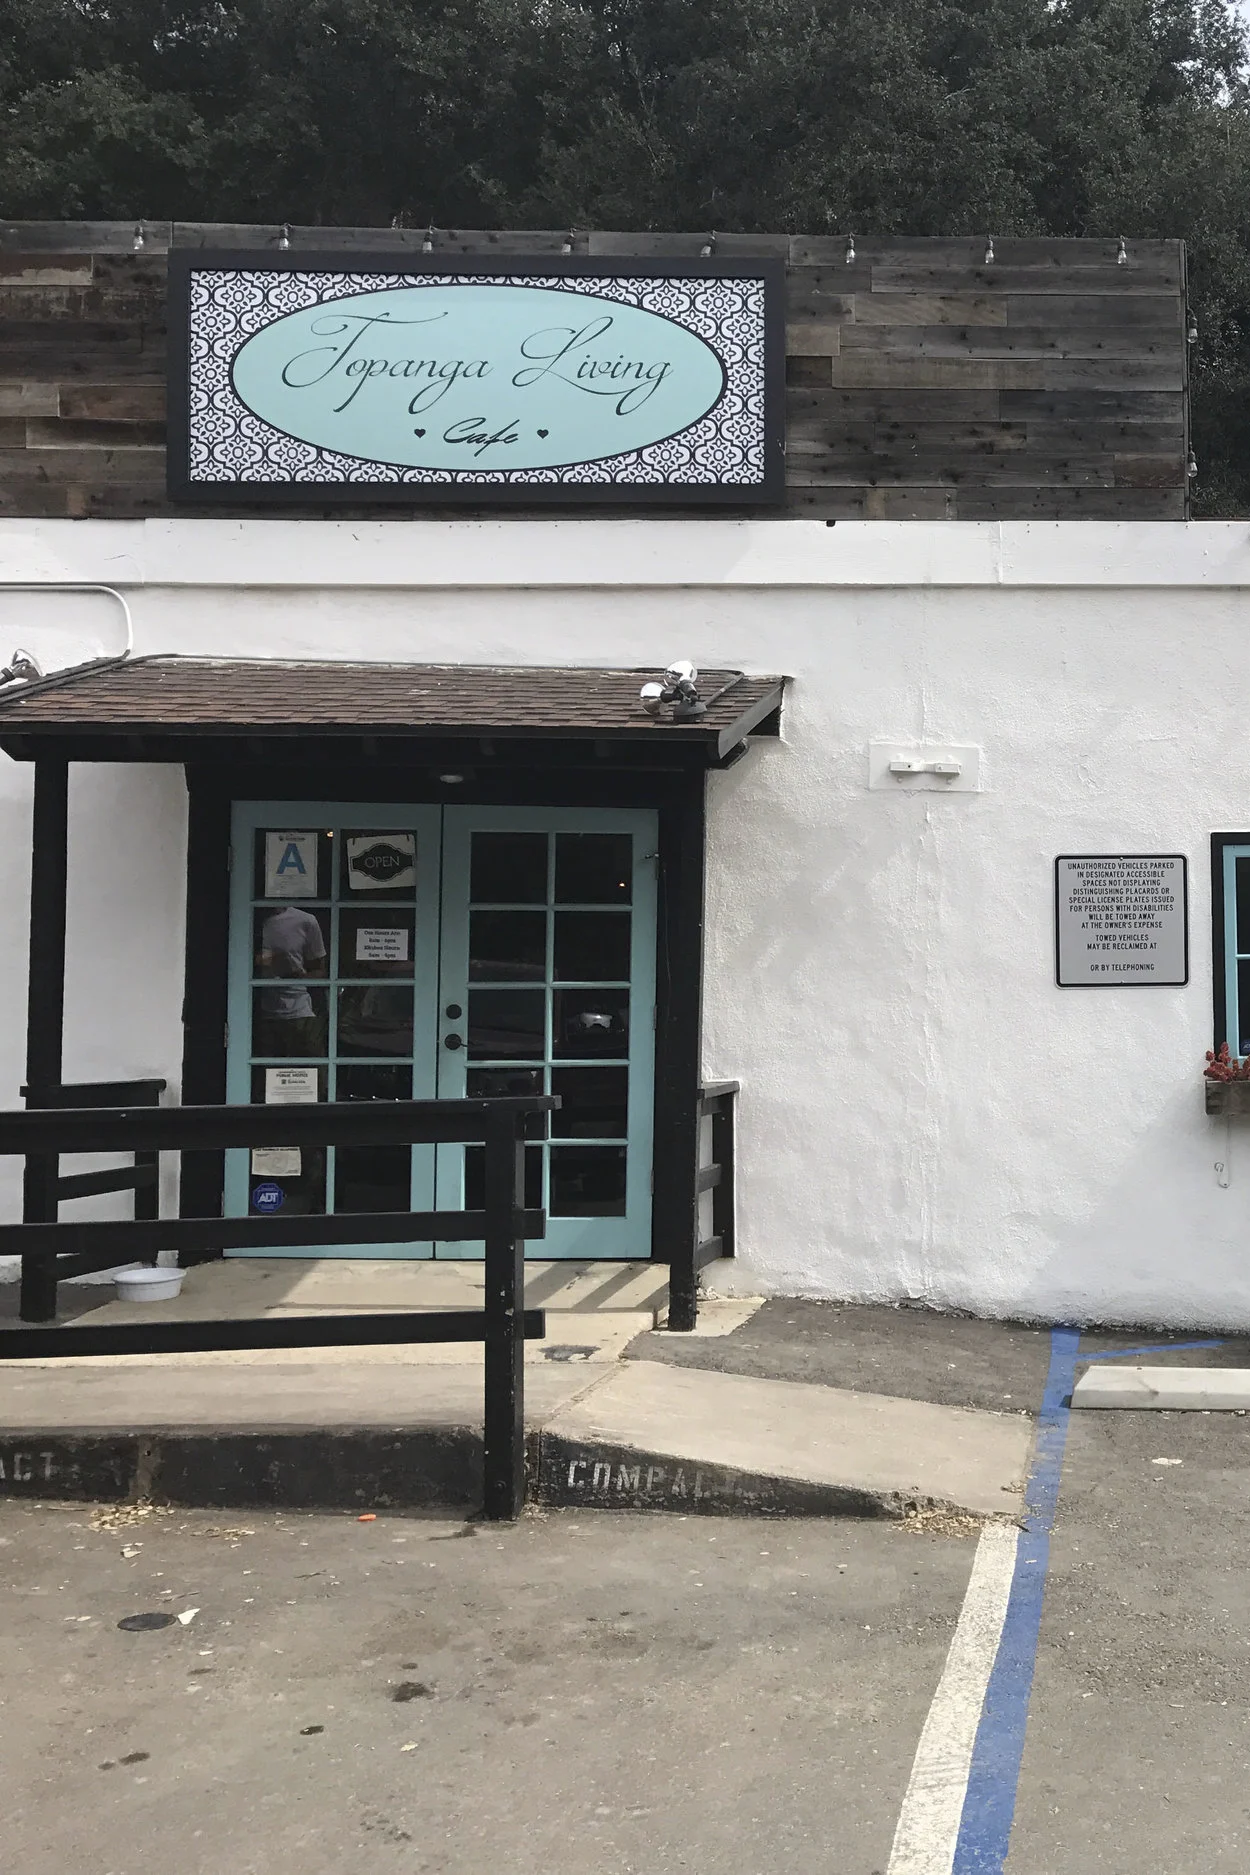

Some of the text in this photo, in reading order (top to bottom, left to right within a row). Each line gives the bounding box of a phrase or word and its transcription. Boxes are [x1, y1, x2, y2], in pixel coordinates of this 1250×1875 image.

[281, 311, 674, 416] Topanga Living
[442, 417, 520, 457] Cafe
[276, 843, 307, 875] A
[364, 855, 400, 869] OPEN
[1068, 862, 1174, 870] UNAUTHORIZED VEHICLES PARKED
[258, 1192, 278, 1204] ADT
[567, 1460, 738, 1498] COMPAC
